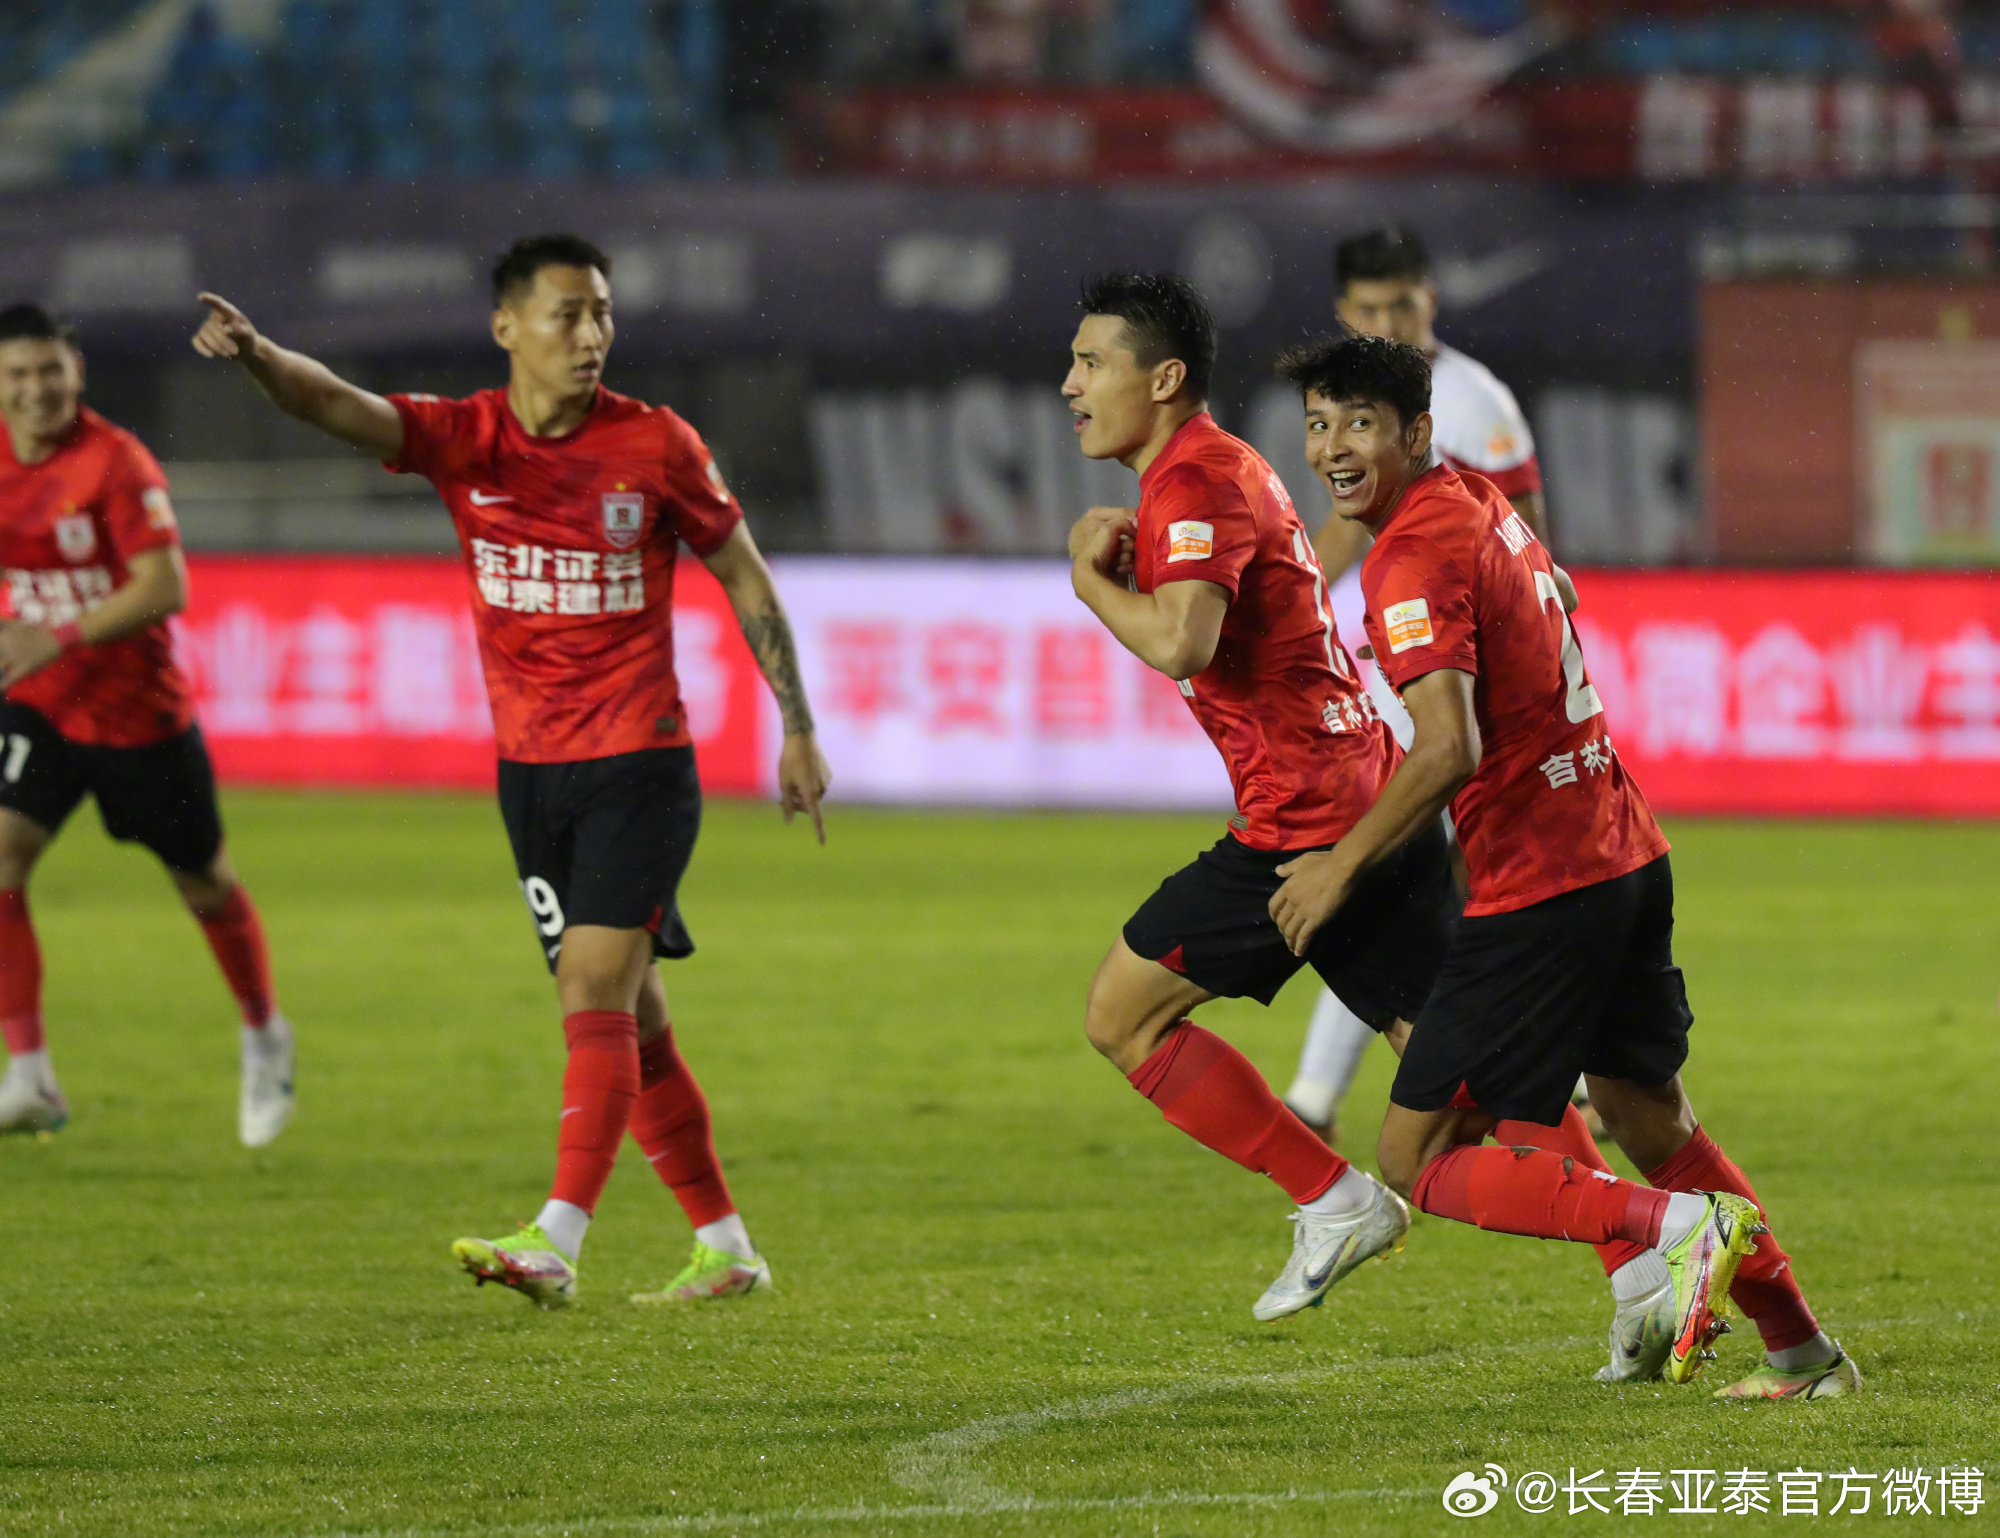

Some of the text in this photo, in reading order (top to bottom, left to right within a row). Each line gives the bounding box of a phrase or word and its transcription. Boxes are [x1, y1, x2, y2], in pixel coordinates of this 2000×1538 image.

[470, 538, 643, 580] 东北证券
[1534, 570, 1604, 724] 2
[1538, 734, 1617, 789] 吉林
